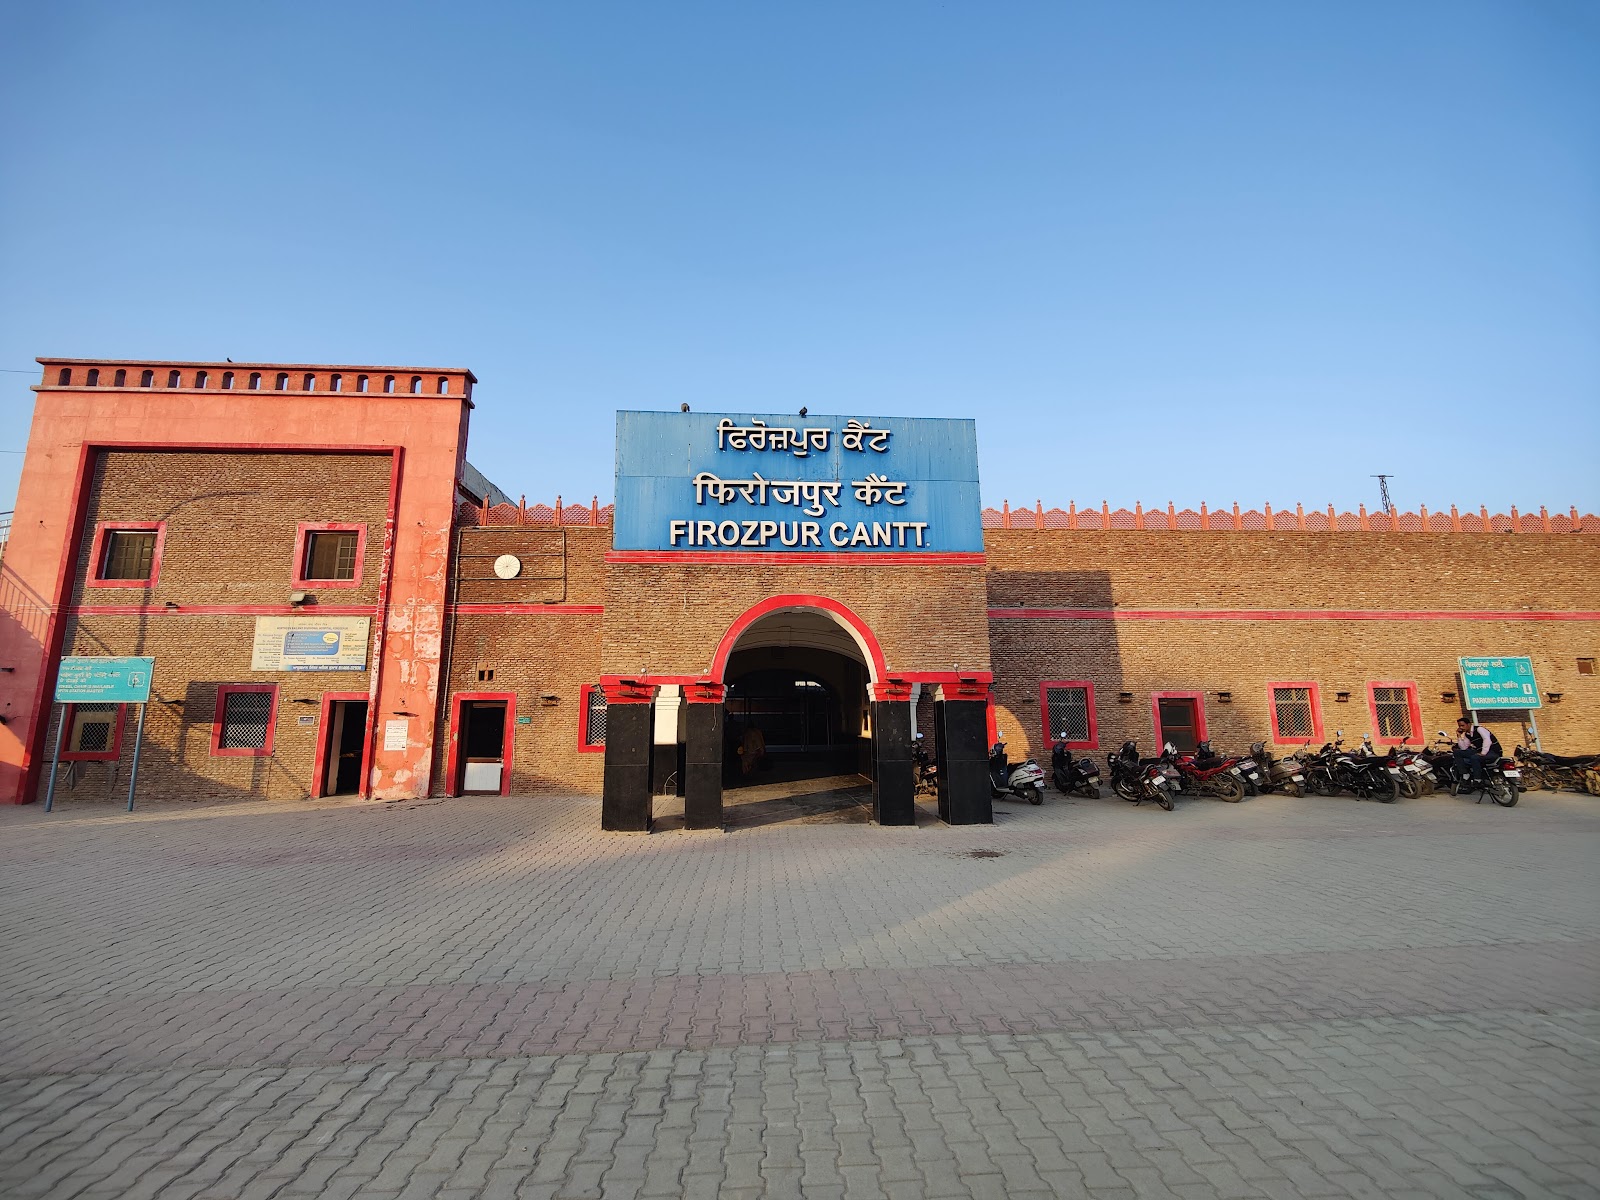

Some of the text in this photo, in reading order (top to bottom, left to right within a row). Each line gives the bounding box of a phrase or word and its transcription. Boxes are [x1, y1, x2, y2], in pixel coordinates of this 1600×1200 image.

[716, 416, 891, 456] ਫਿਰੋਜ਼ਪੁਰ ਕੈਂਟ
[692, 471, 907, 517] फिरोजपुर कैंट
[669, 519, 822, 547] FIROZPUR
